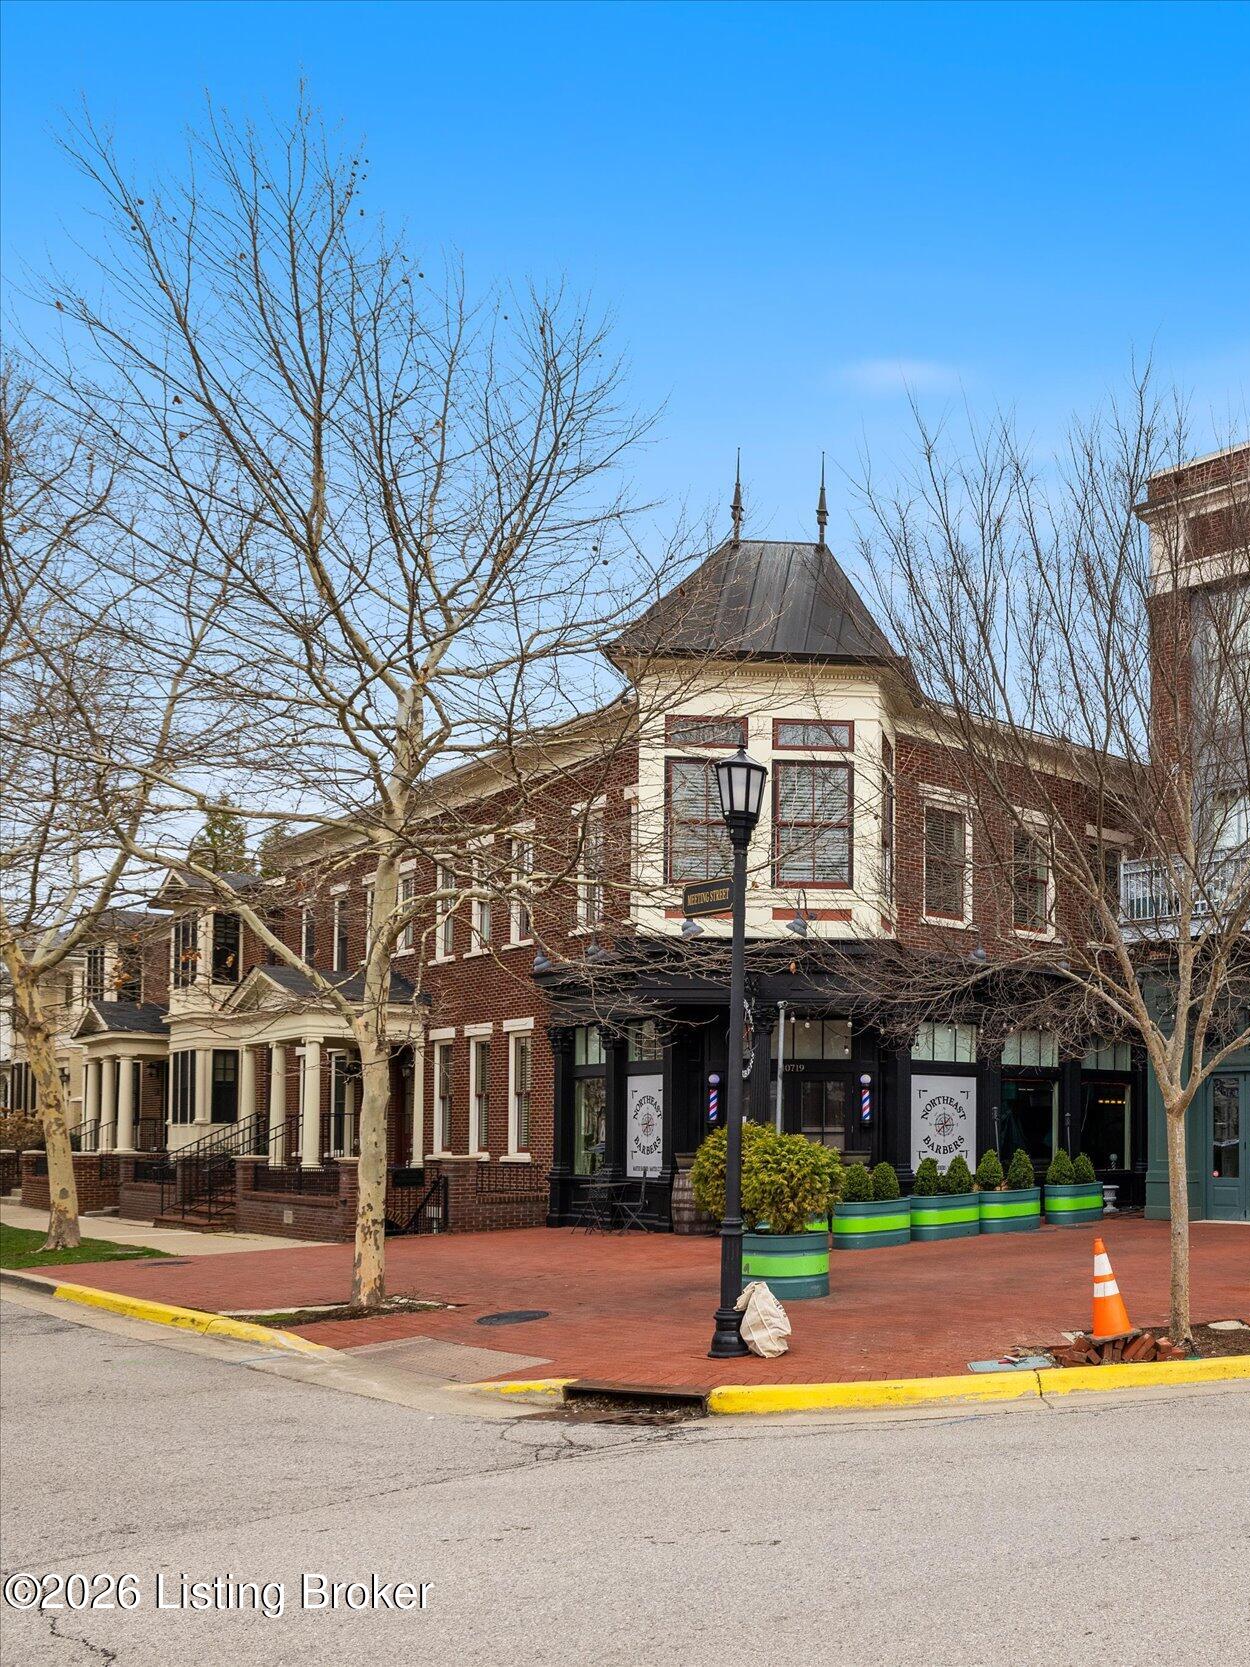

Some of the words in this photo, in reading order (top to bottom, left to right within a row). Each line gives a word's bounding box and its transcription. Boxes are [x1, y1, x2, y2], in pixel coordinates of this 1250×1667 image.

[687, 892, 709, 906] MEETING
[709, 888, 730, 902] STREET
[783, 1063, 805, 1072] 0719
[632, 1095, 663, 1120] NORTHEAST
[920, 1095, 967, 1120] NORTHEAST
[634, 1135, 662, 1155] BARBERS
[922, 1135, 965, 1155] BARBERS
